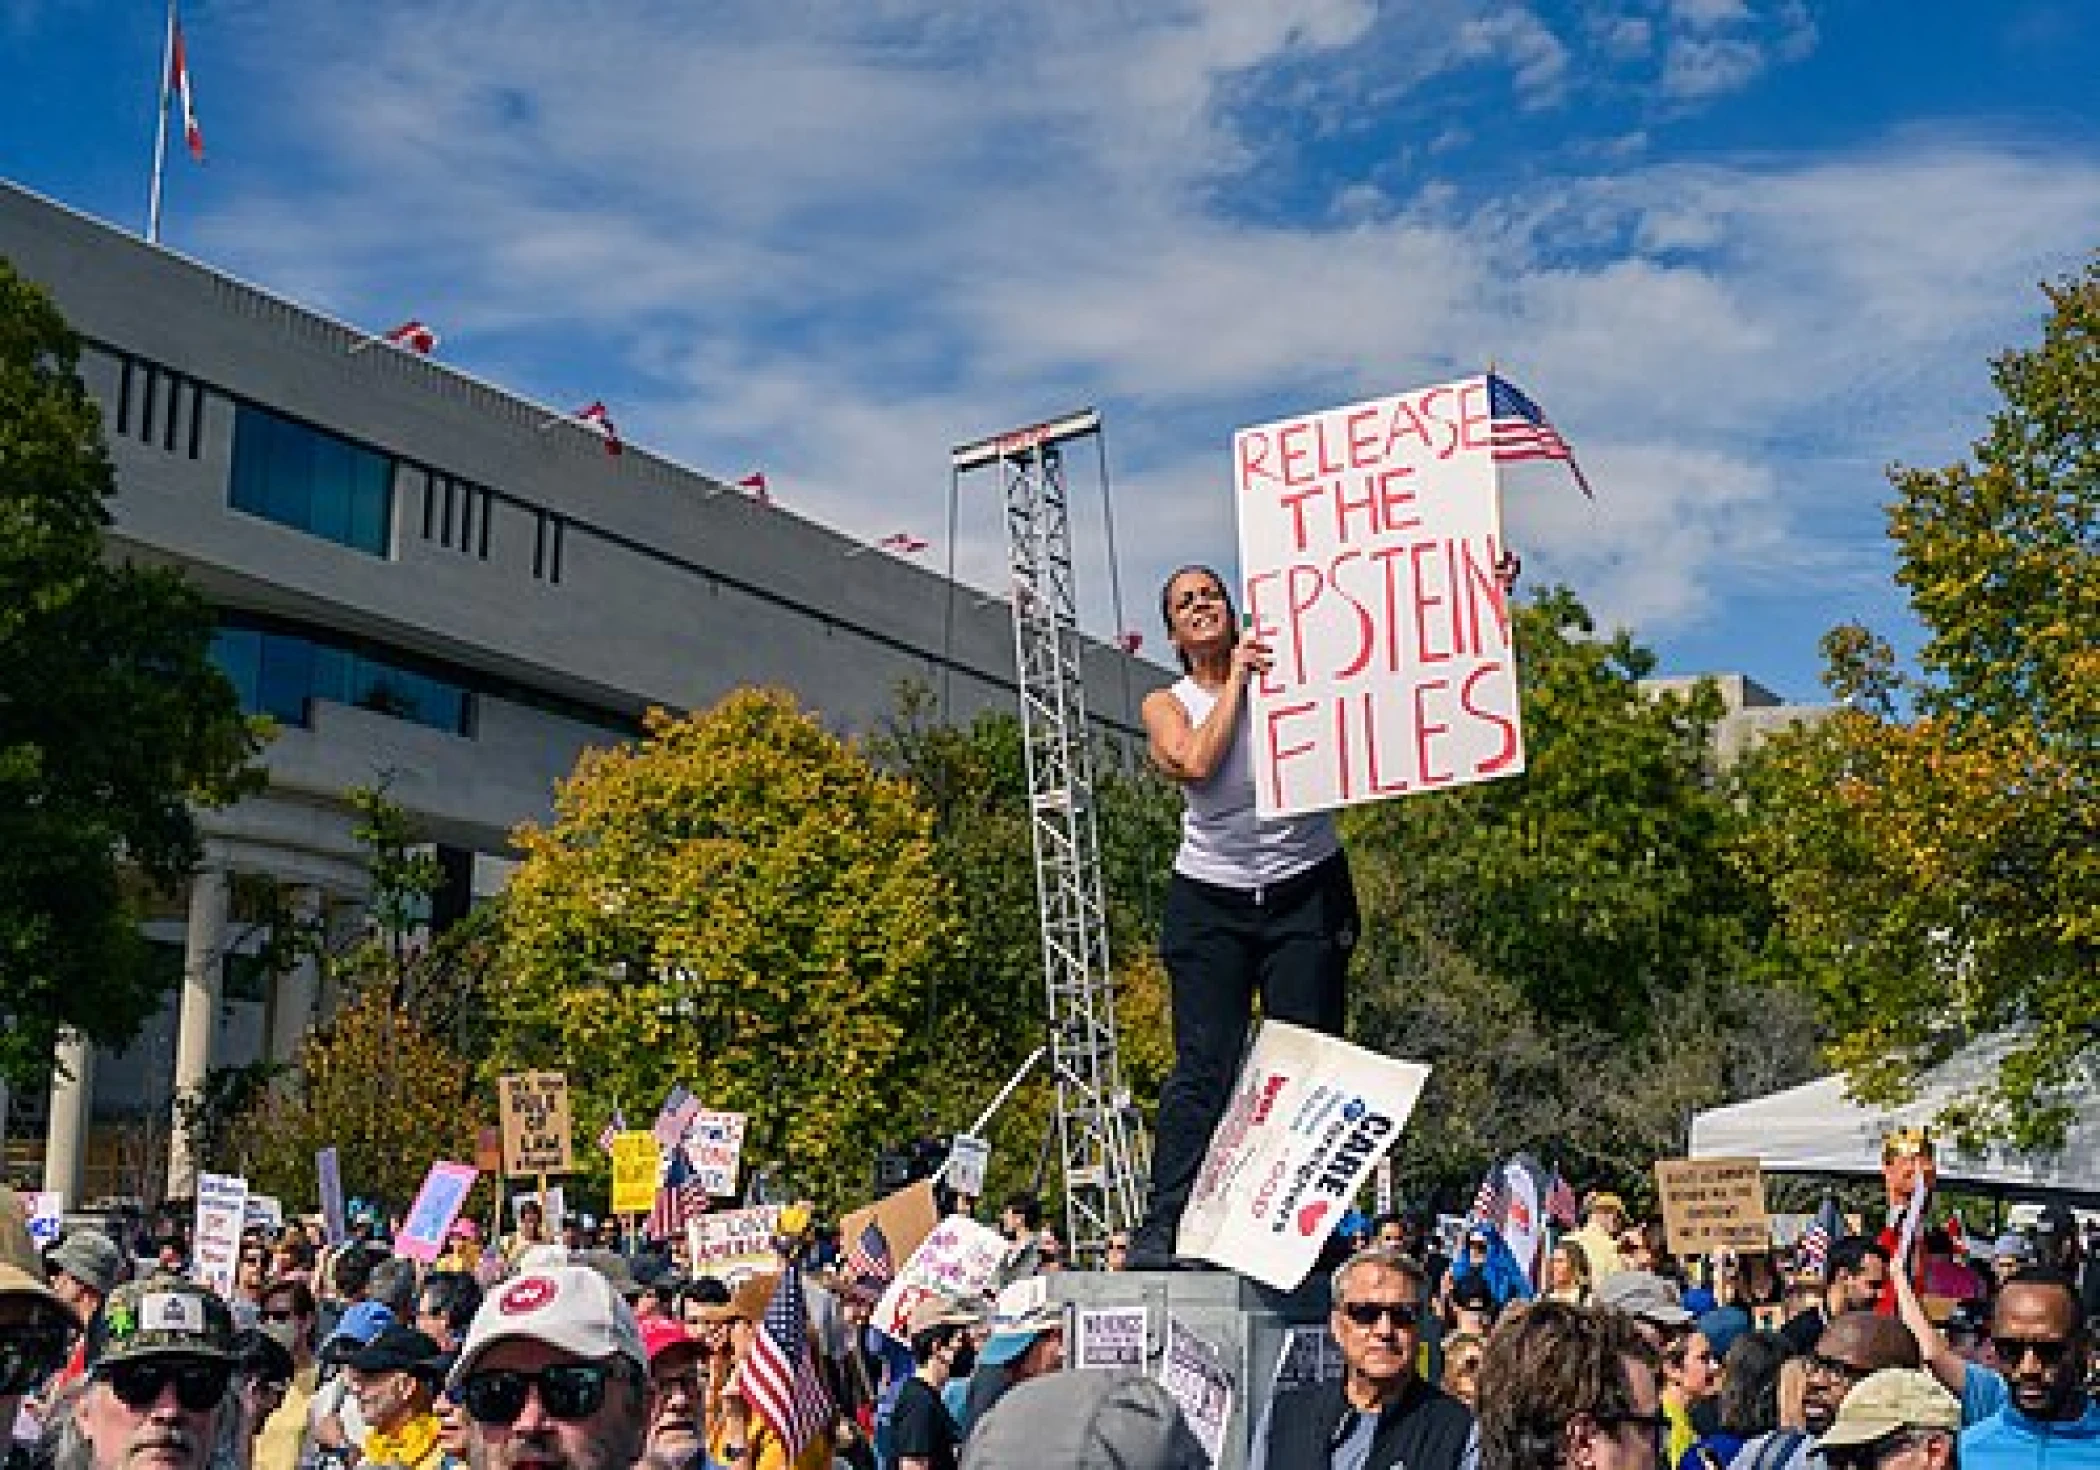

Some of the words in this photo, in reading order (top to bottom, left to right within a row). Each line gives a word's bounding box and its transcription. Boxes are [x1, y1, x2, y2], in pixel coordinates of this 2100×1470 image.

[1239, 384, 1488, 489] RELEASE
[1281, 467, 1421, 552] THE
[1247, 534, 1509, 693] EPSTEIN
[1267, 662, 1517, 808] FILES
[1314, 1112, 1394, 1198] CARE
